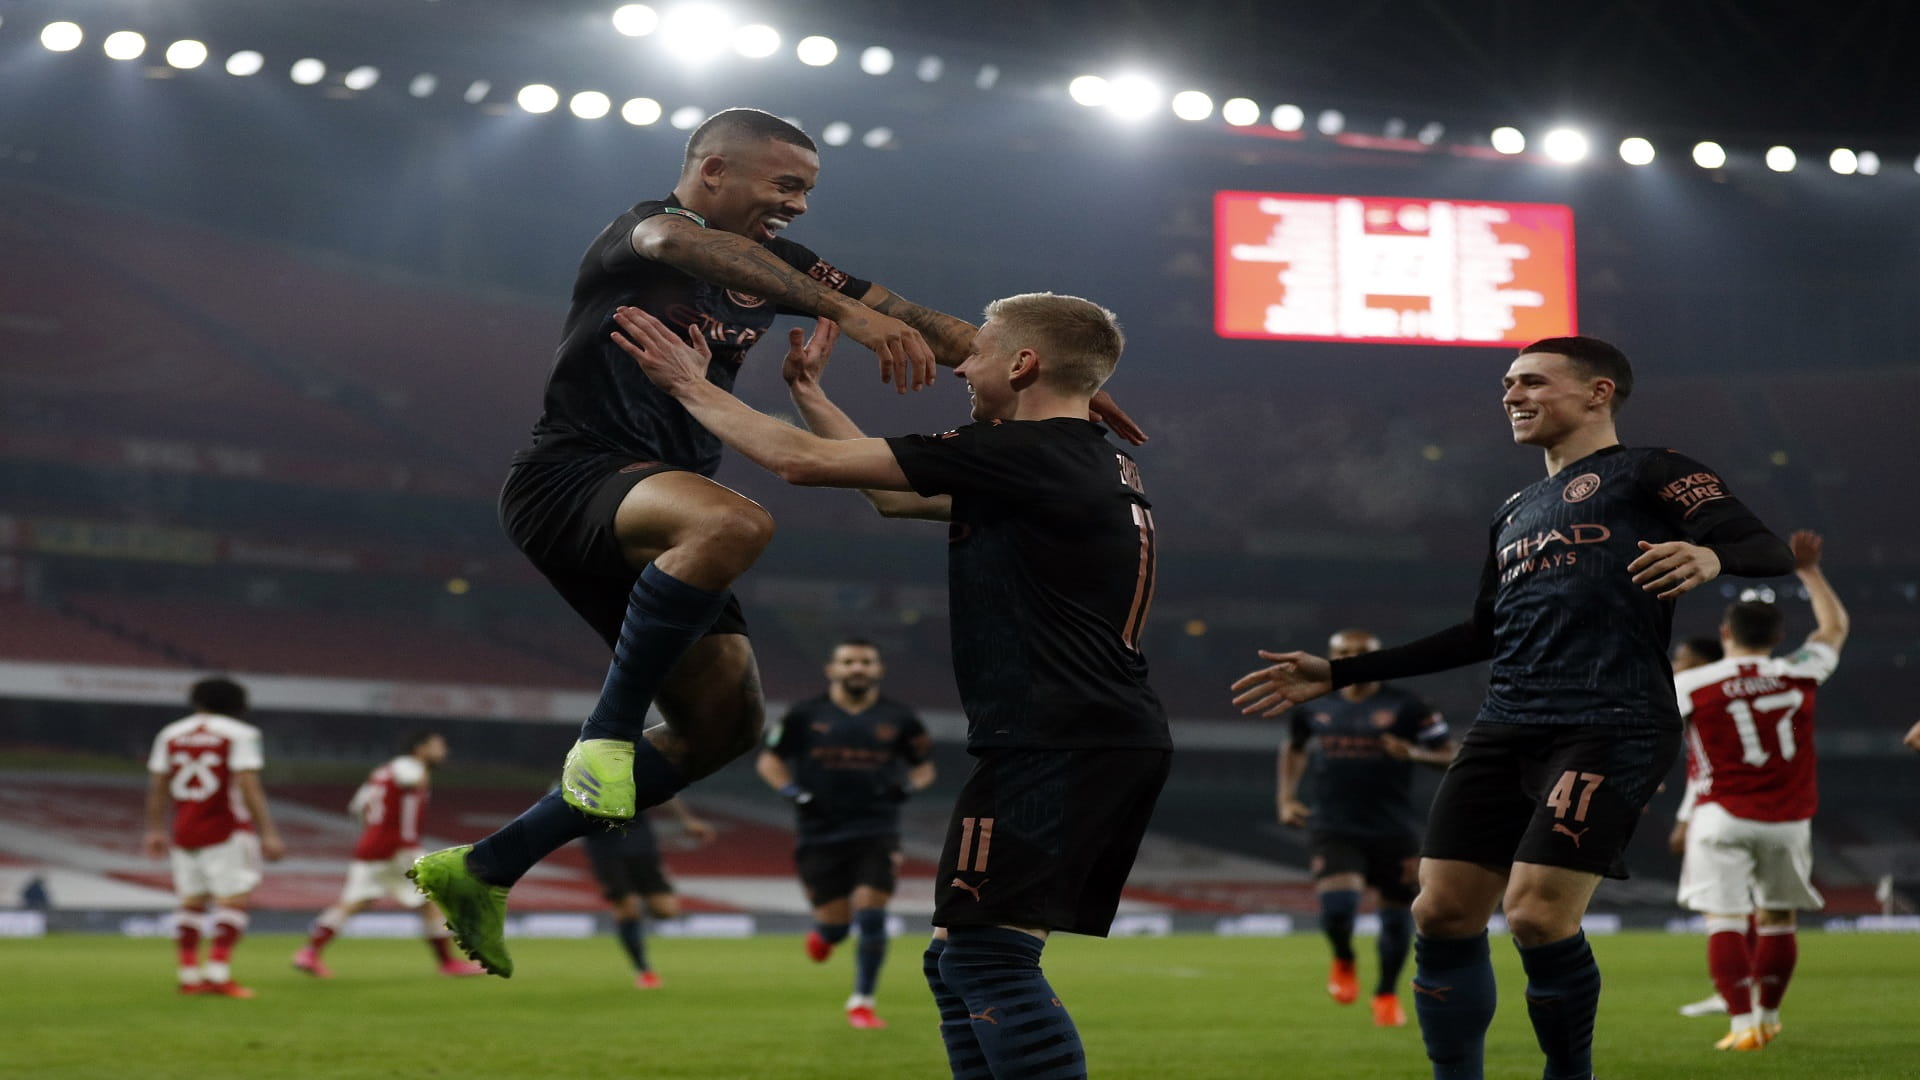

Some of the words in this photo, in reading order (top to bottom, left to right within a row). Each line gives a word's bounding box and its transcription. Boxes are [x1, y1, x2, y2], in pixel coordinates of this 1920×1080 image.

[1675, 483, 1723, 507] TIRE
[1725, 686, 1804, 768] 17
[1546, 769, 1605, 823] 47
[957, 817, 995, 873] 11
